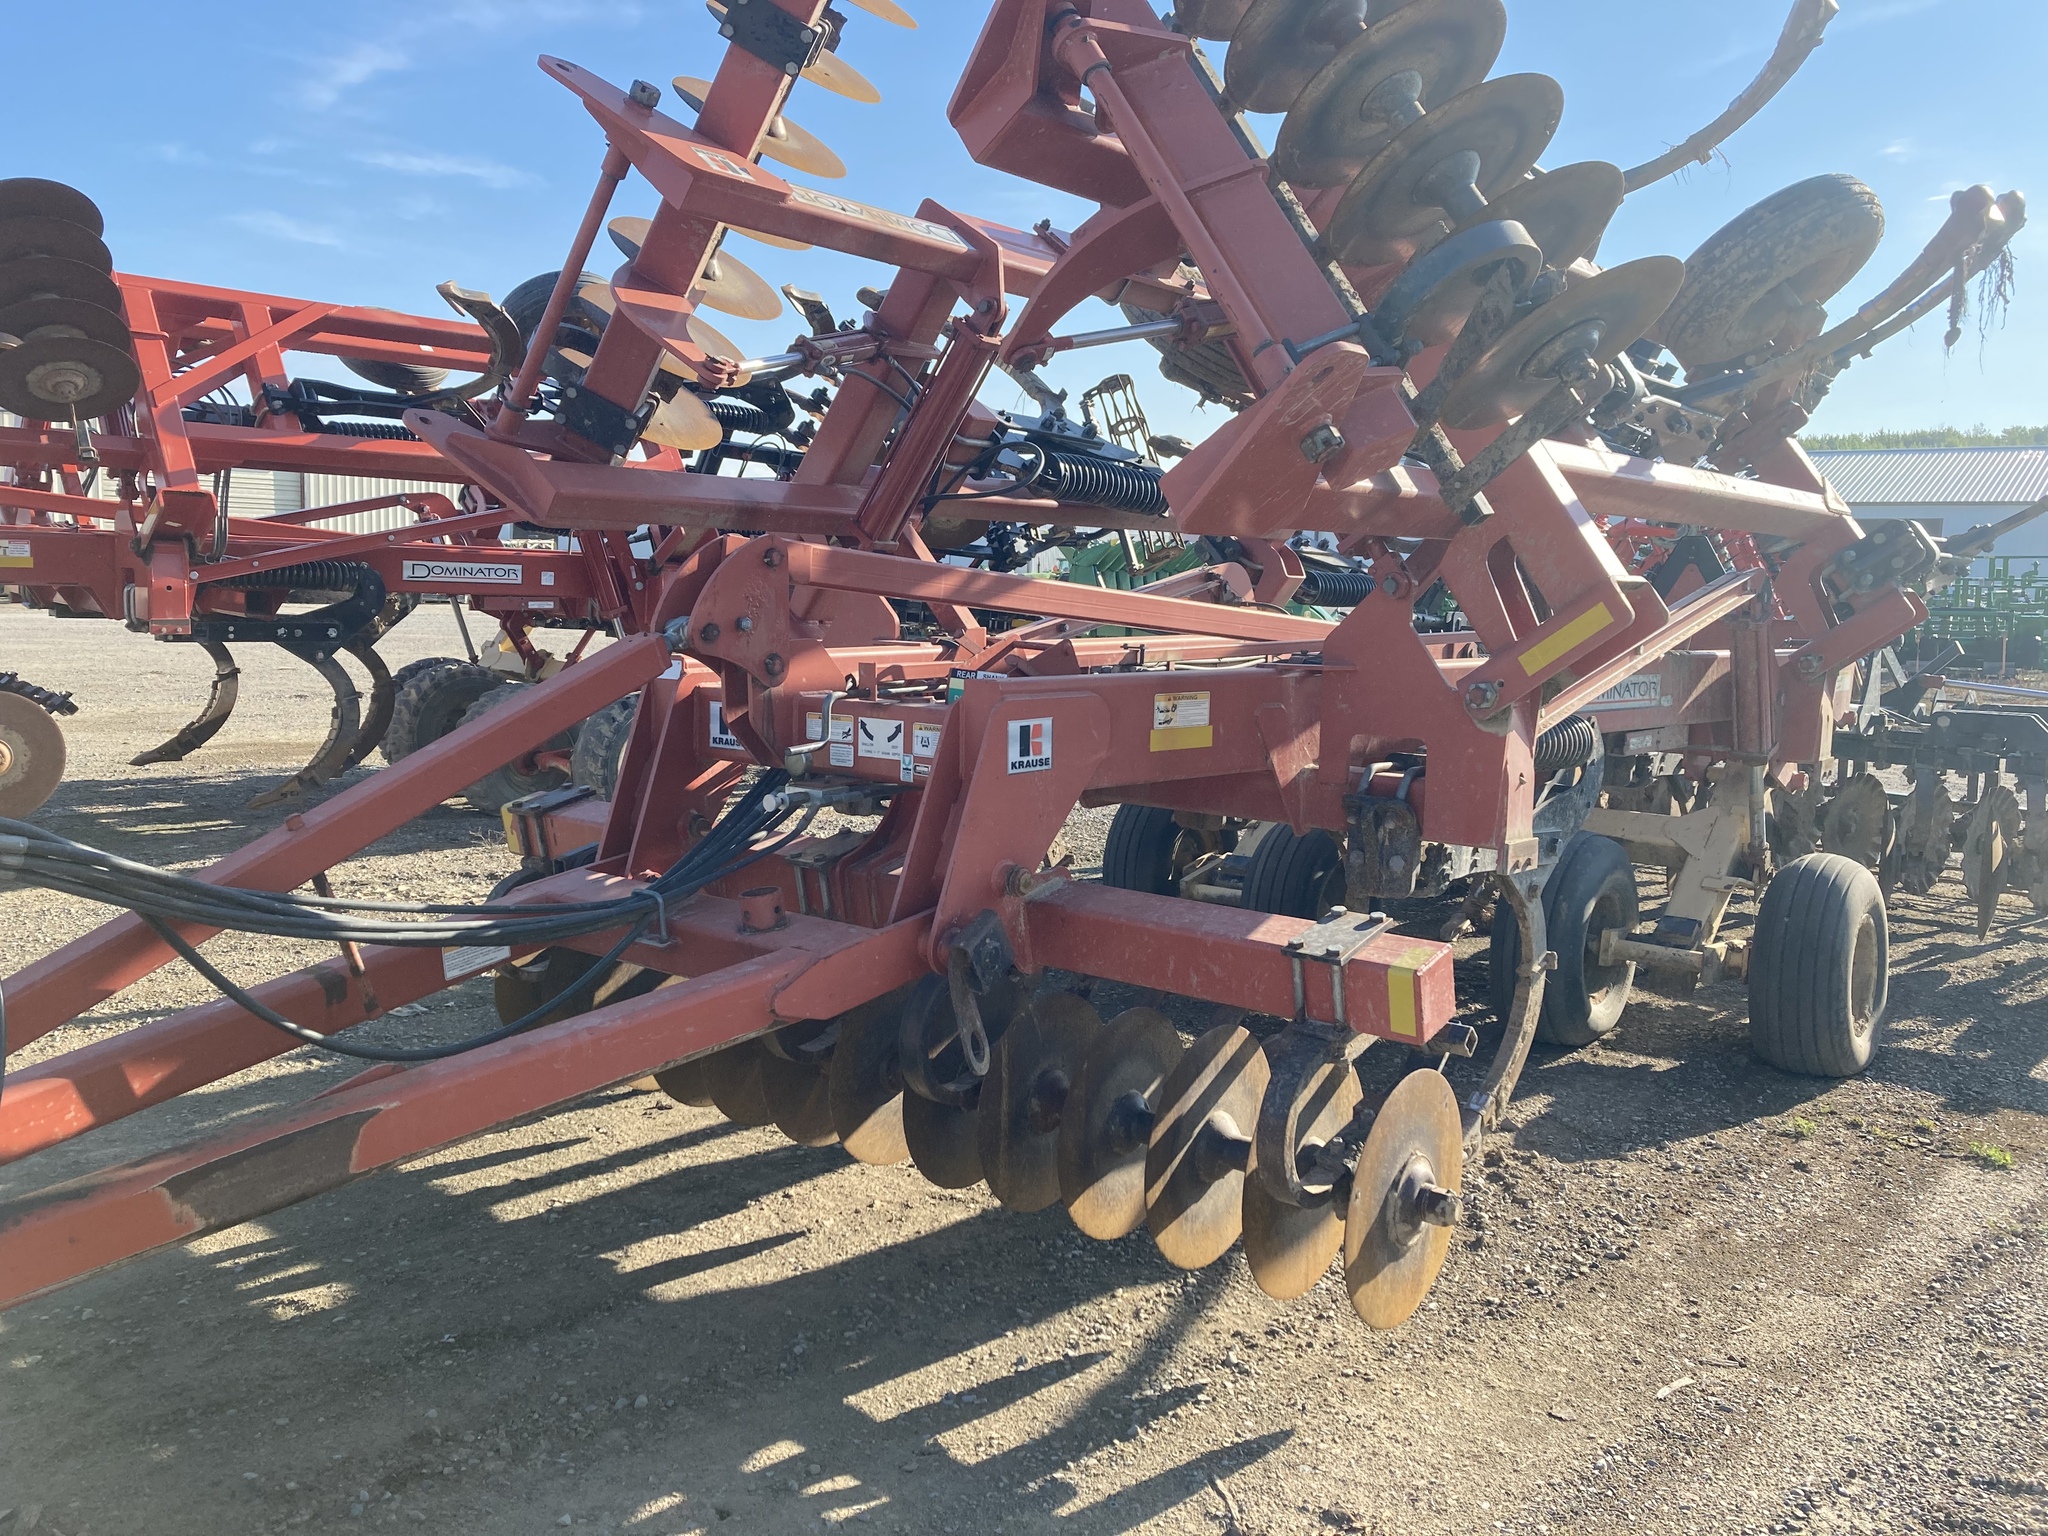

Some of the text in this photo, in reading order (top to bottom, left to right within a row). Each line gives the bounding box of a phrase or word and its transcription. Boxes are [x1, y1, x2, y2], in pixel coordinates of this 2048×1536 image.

[407, 563, 519, 579] DOMINATOR
[956, 670, 976, 679] REAR
[1597, 681, 1658, 699] INATOR
[1172, 694, 1198, 702] WARNING
[712, 736, 741, 747] KRAUS
[1011, 757, 1050, 770] KRAUSE
